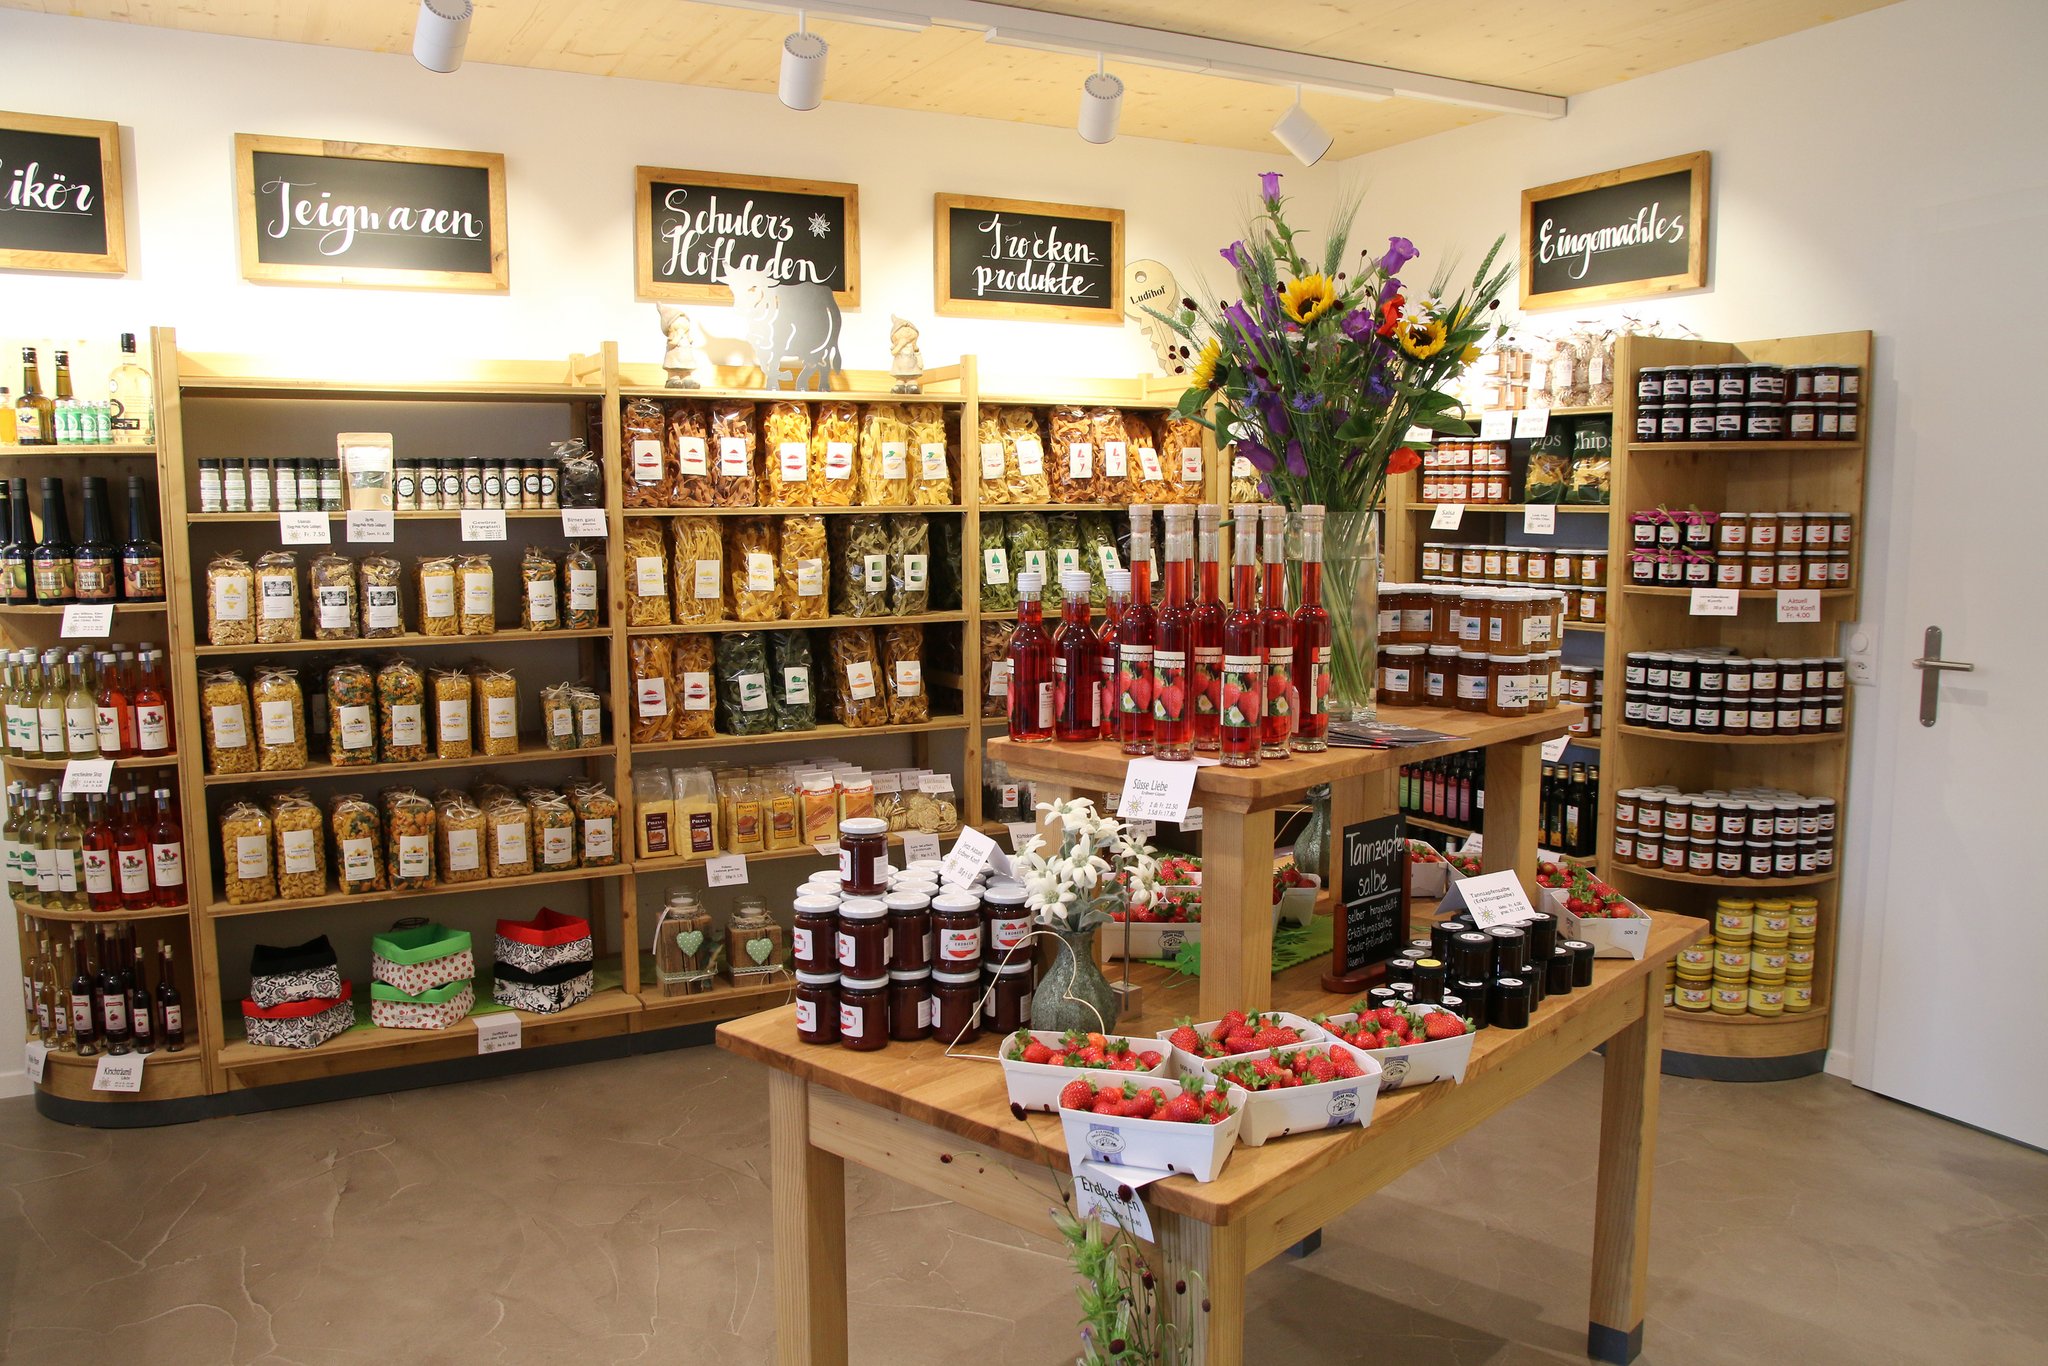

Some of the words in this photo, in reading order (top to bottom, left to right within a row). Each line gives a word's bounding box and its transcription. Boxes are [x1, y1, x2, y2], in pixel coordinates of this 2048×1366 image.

[261, 176, 484, 257] Teigwaren
[661, 222, 837, 284] Hofladen
[972, 262, 1097, 297] produkte
[1128, 284, 1167, 306] Ludihof
[1132, 778, 1150, 790] Süsse
[1151, 780, 1169, 792] Liebe
[1345, 823, 1405, 867] Tannzapfen
[1357, 868, 1389, 897] salbe
[1347, 908, 1366, 924] selber
[1333, 1094, 1345, 1102] VOM
[1081, 1176, 1141, 1213] Erdbeeen
